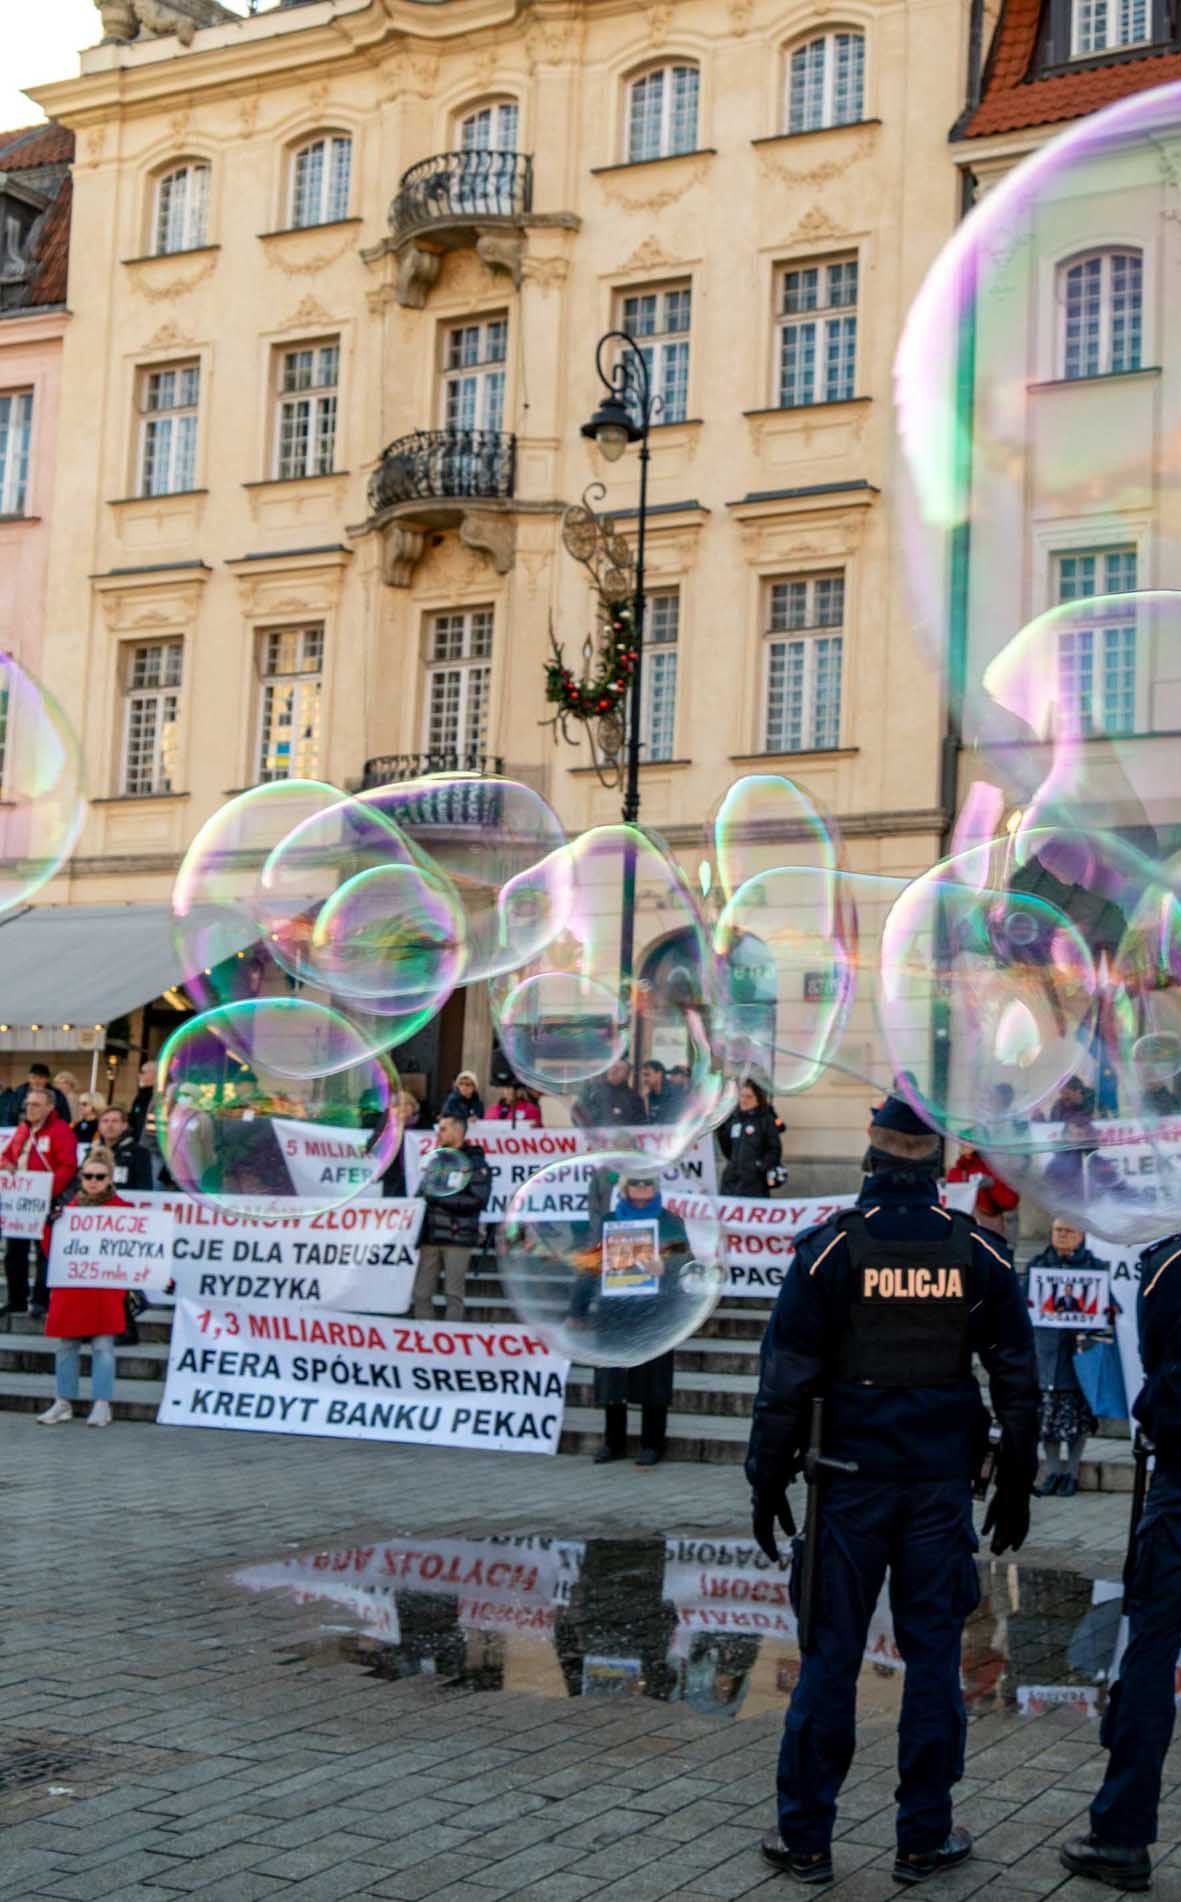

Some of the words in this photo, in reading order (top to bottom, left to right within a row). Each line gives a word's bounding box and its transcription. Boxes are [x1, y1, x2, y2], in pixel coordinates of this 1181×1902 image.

[287, 1138, 297, 1156] 5
[466, 1130, 576, 1156] ILIONÓW
[69, 1214, 147, 1234] DOTACJE
[309, 1207, 417, 1230] ZŁOTYCH
[63, 1238, 89, 1256] dla
[99, 1238, 164, 1259] RYDZYKA
[172, 1237, 223, 1261] CJE
[232, 1240, 283, 1263] DLA
[293, 1242, 414, 1266] TADEUSZA
[67, 1261, 99, 1280] 325
[864, 1267, 963, 1298] POLICJA
[200, 1273, 321, 1300] RYDZYKA
[196, 1309, 240, 1341] 1,3
[250, 1315, 386, 1352] MILIARDA
[394, 1327, 551, 1359] ZŁOTYCH
[177, 1347, 281, 1380] AFERA
[292, 1353, 402, 1390] SPÓŁKI
[412, 1367, 563, 1399] SREBRNA
[190, 1388, 319, 1424] KREDYT
[326, 1399, 441, 1432] BANKU
